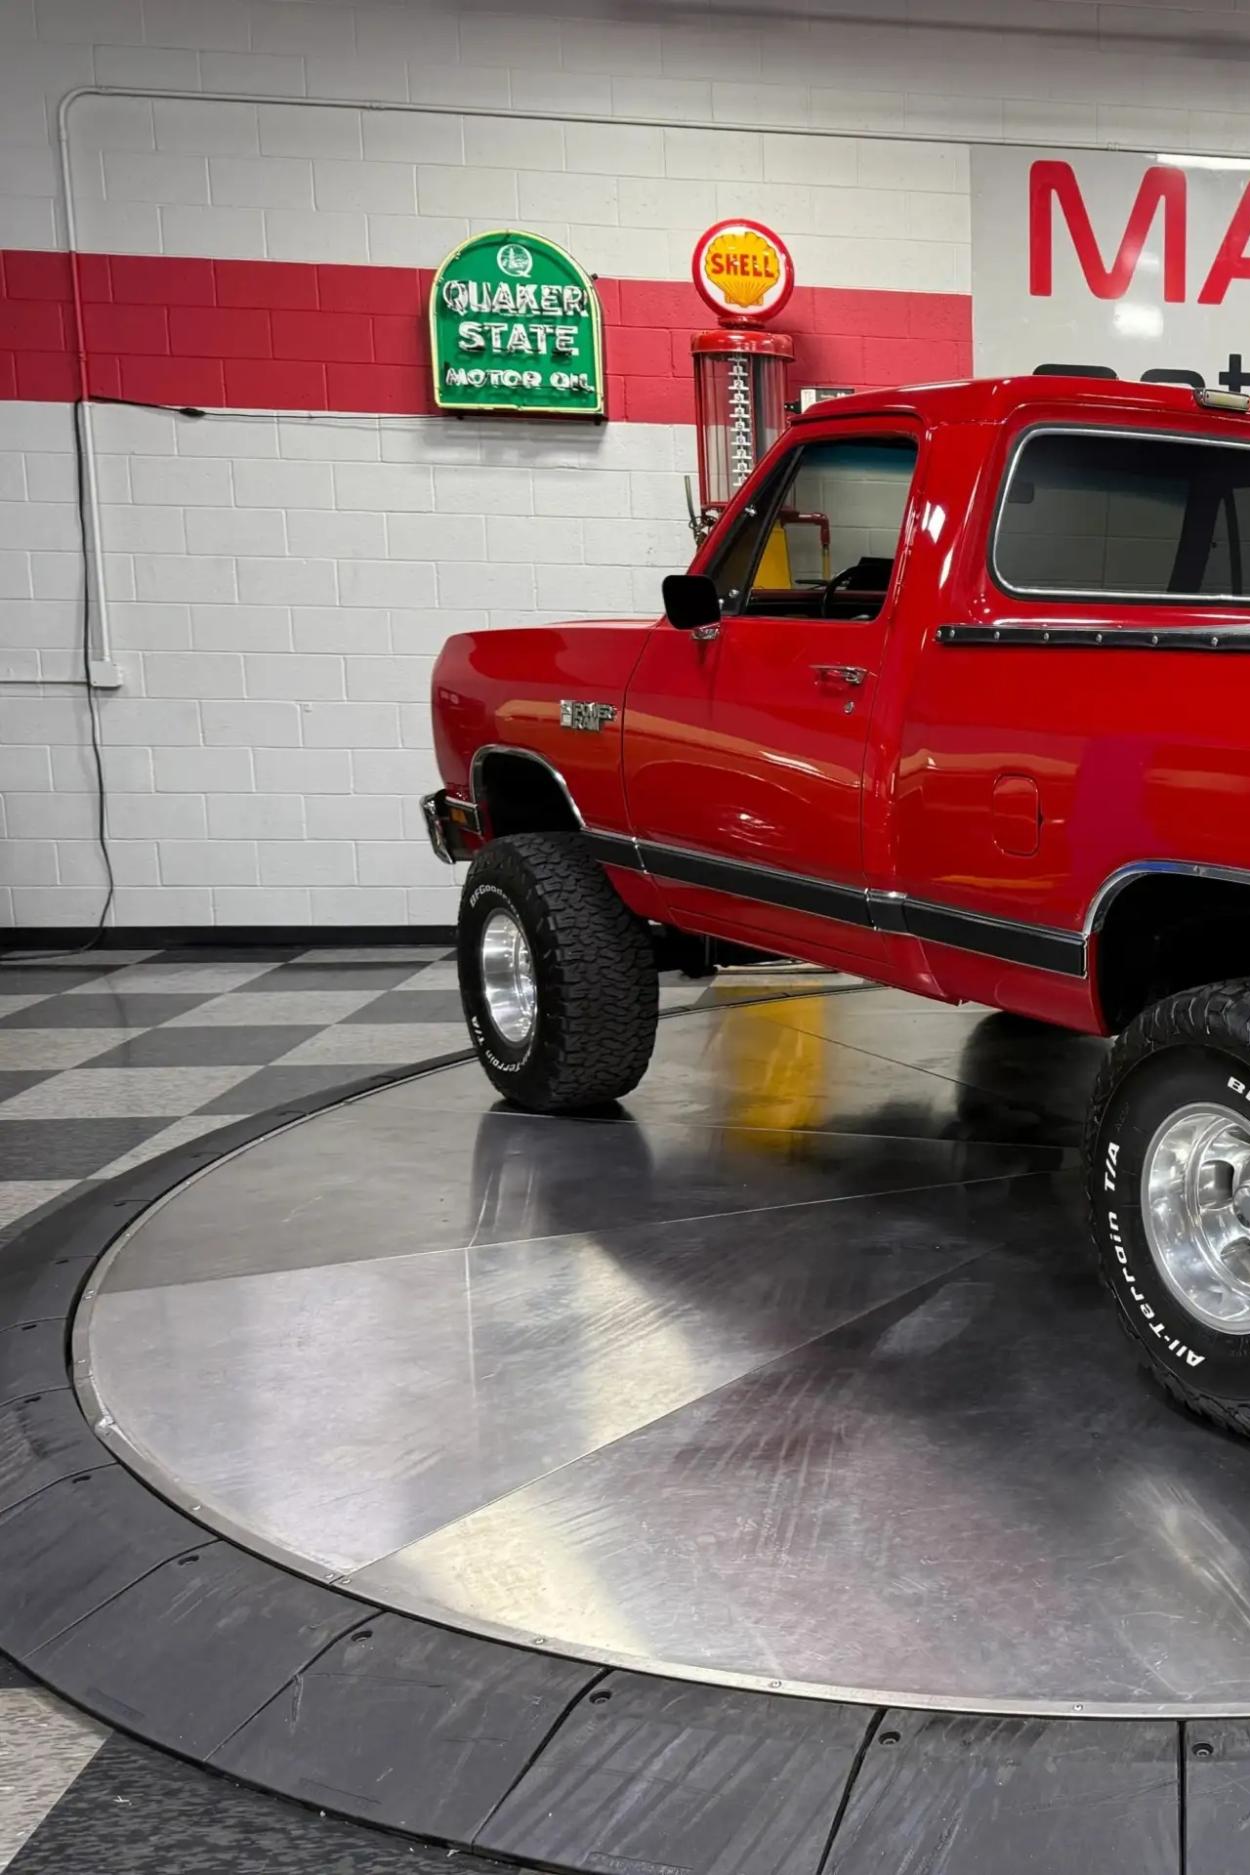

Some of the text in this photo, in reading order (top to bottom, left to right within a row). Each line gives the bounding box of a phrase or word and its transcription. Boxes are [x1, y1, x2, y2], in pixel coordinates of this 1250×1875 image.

[711, 252, 775, 279] SHELL
[443, 280, 589, 317] QUAKER
[458, 321, 580, 356] STATE
[445, 367, 595, 393] MOTOR OIL
[1104, 1142, 1206, 1367] All-Terrain T/A
